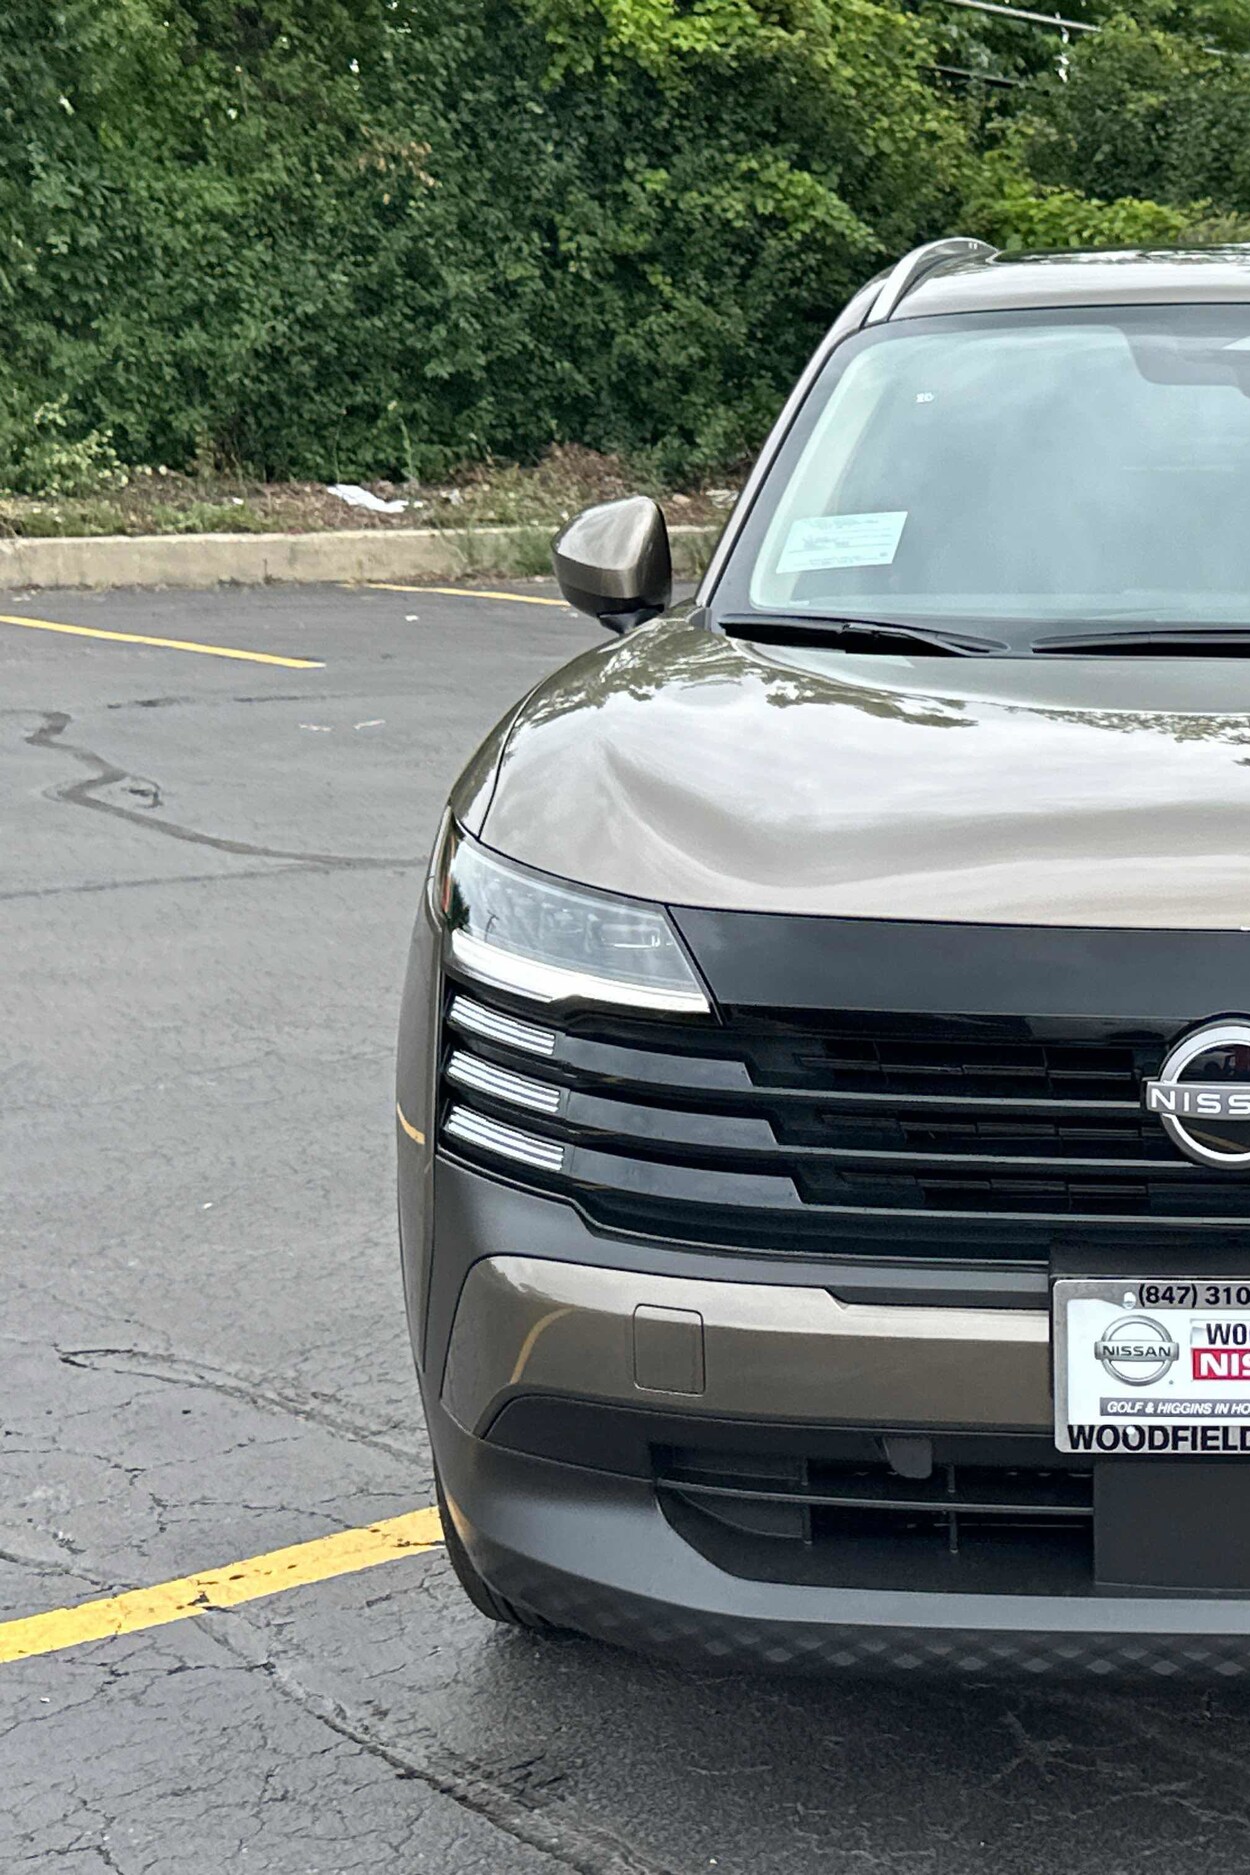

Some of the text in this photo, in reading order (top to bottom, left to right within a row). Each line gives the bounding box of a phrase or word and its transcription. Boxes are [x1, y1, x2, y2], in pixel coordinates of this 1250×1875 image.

[1138, 1283, 1198, 1308] (847)
[1102, 1344, 1172, 1358] NISSAN
[1107, 1401, 1144, 1413] GOLF
[1145, 1401, 1155, 1413] &
[1158, 1401, 1213, 1414] HIGGINS
[1214, 1401, 1228, 1414] IN
